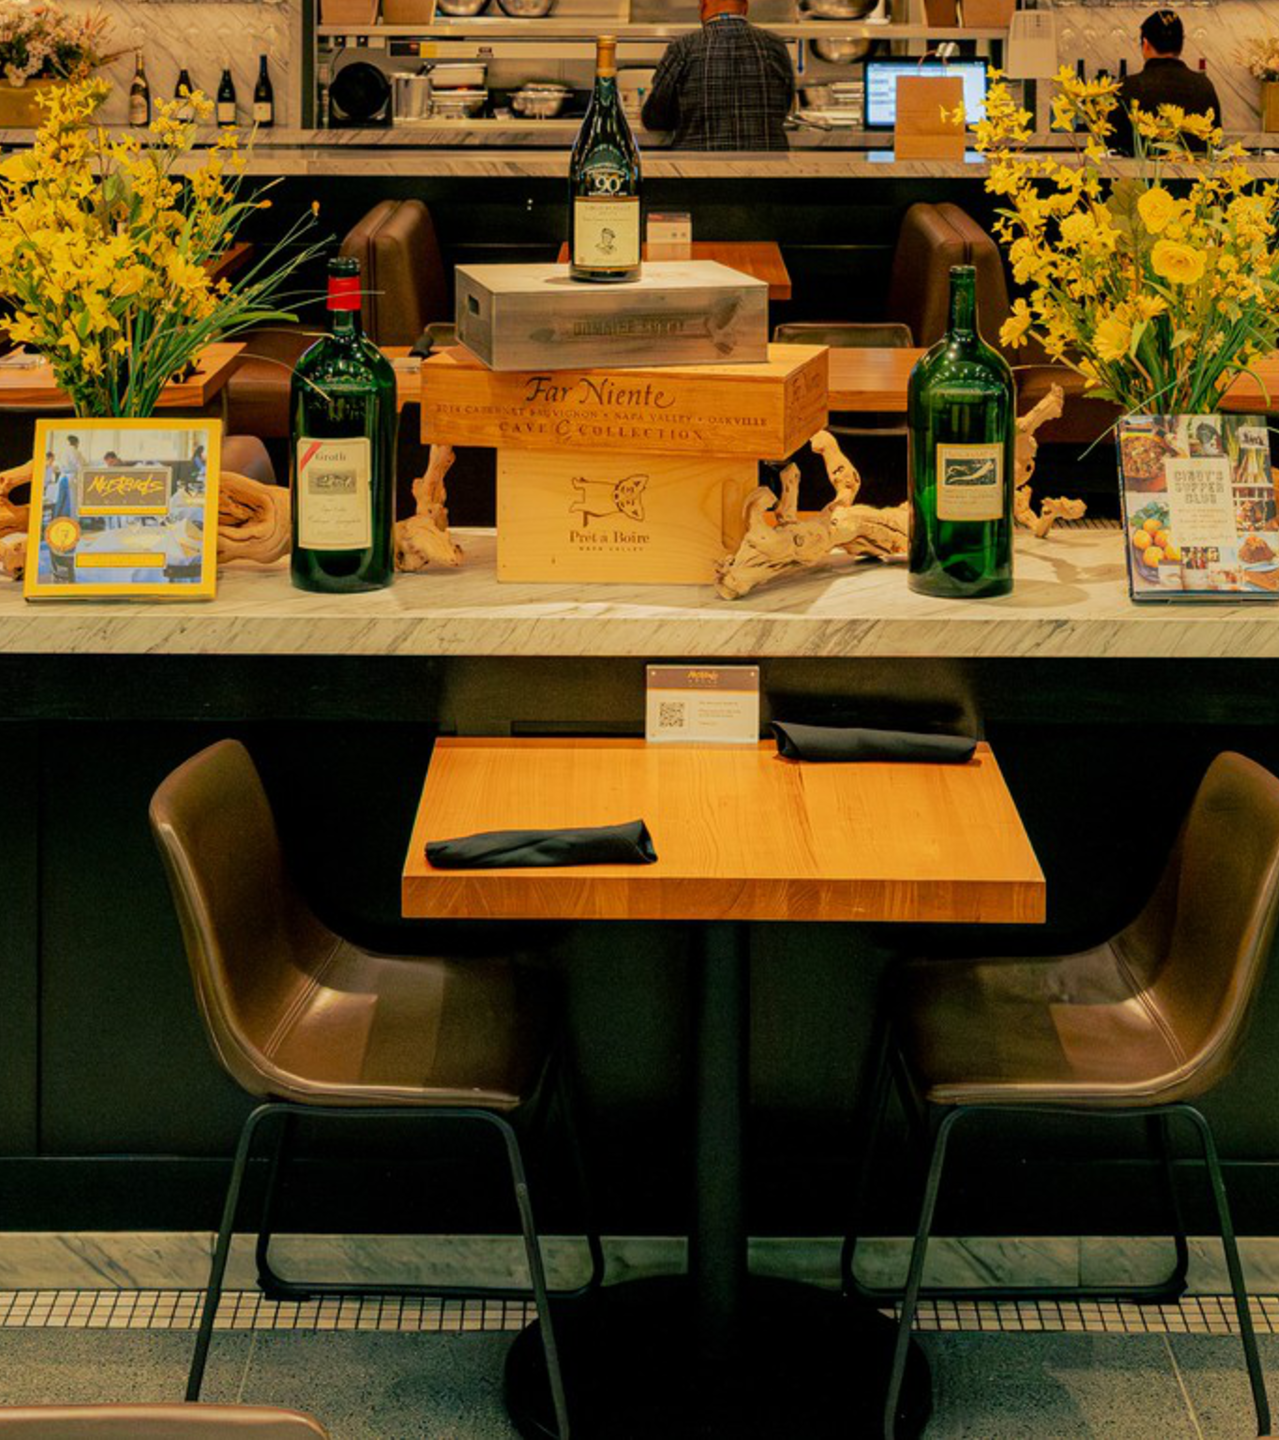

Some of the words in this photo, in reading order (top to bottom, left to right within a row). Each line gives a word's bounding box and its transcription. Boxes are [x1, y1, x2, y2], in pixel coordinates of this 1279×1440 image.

[523, 375, 573, 403] Far
[578, 377, 677, 408] Niente
[614, 411, 645, 422] NAPA
[649, 412, 694, 424] VALLEY
[707, 415, 769, 428] OAKVILLE
[498, 421, 546, 435] CAVE
[578, 425, 705, 441] COLLECTION
[86, 473, 166, 498] Mustards
